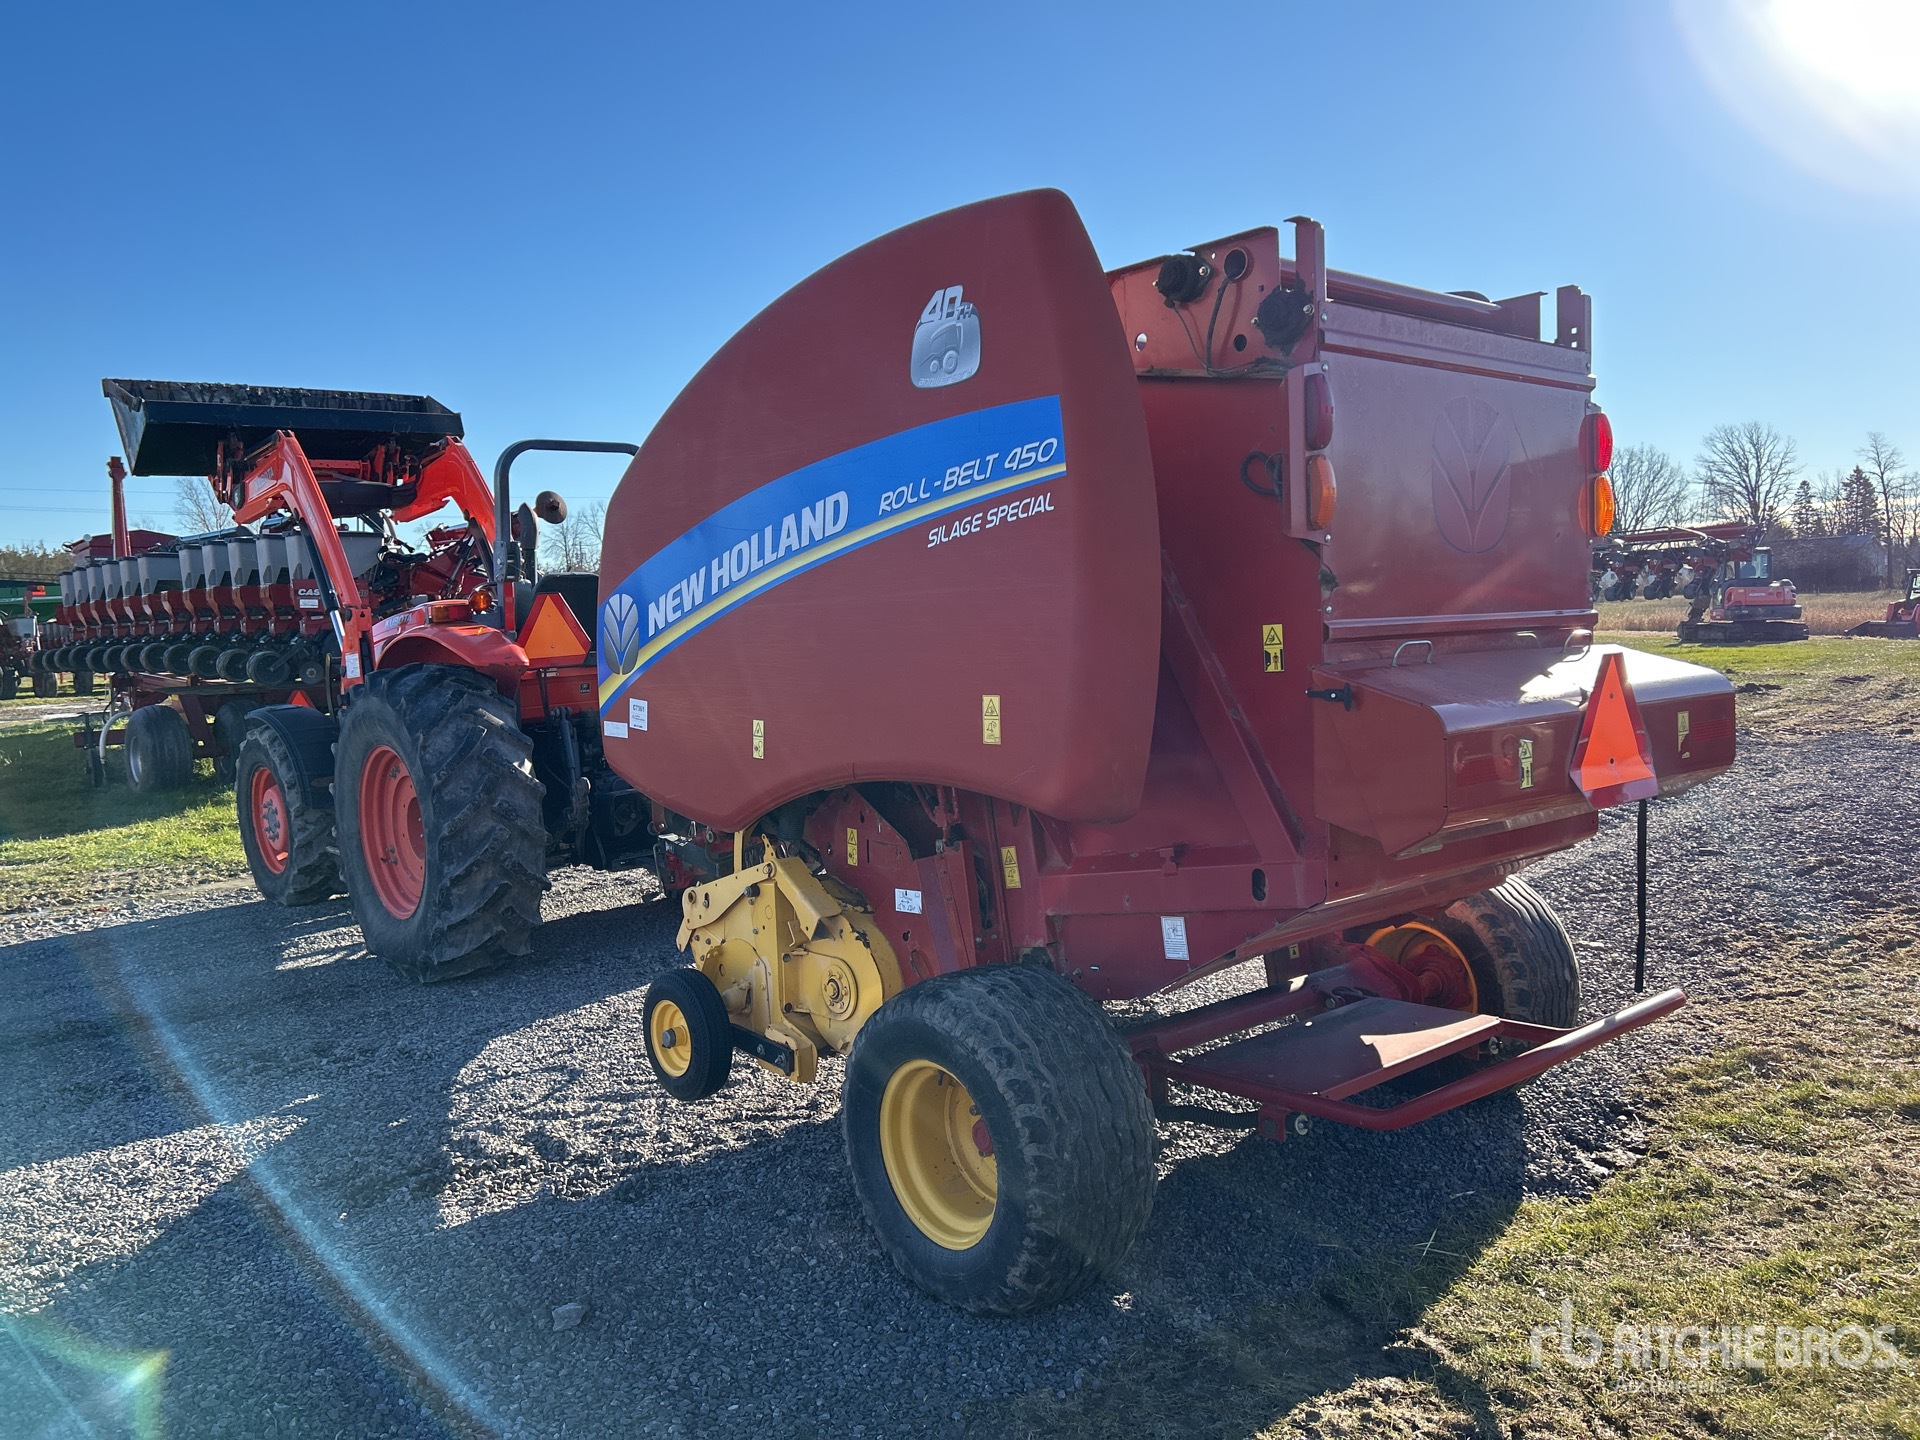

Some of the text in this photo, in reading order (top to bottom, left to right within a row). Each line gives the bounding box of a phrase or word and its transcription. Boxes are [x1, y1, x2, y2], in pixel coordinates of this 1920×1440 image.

[878, 437, 1058, 516] ROLL-BELT 450
[927, 492, 1055, 548] SILAGE SPECIAL
[297, 588, 320, 596] CAS
[648, 490, 849, 638] NEW HOLLAND
